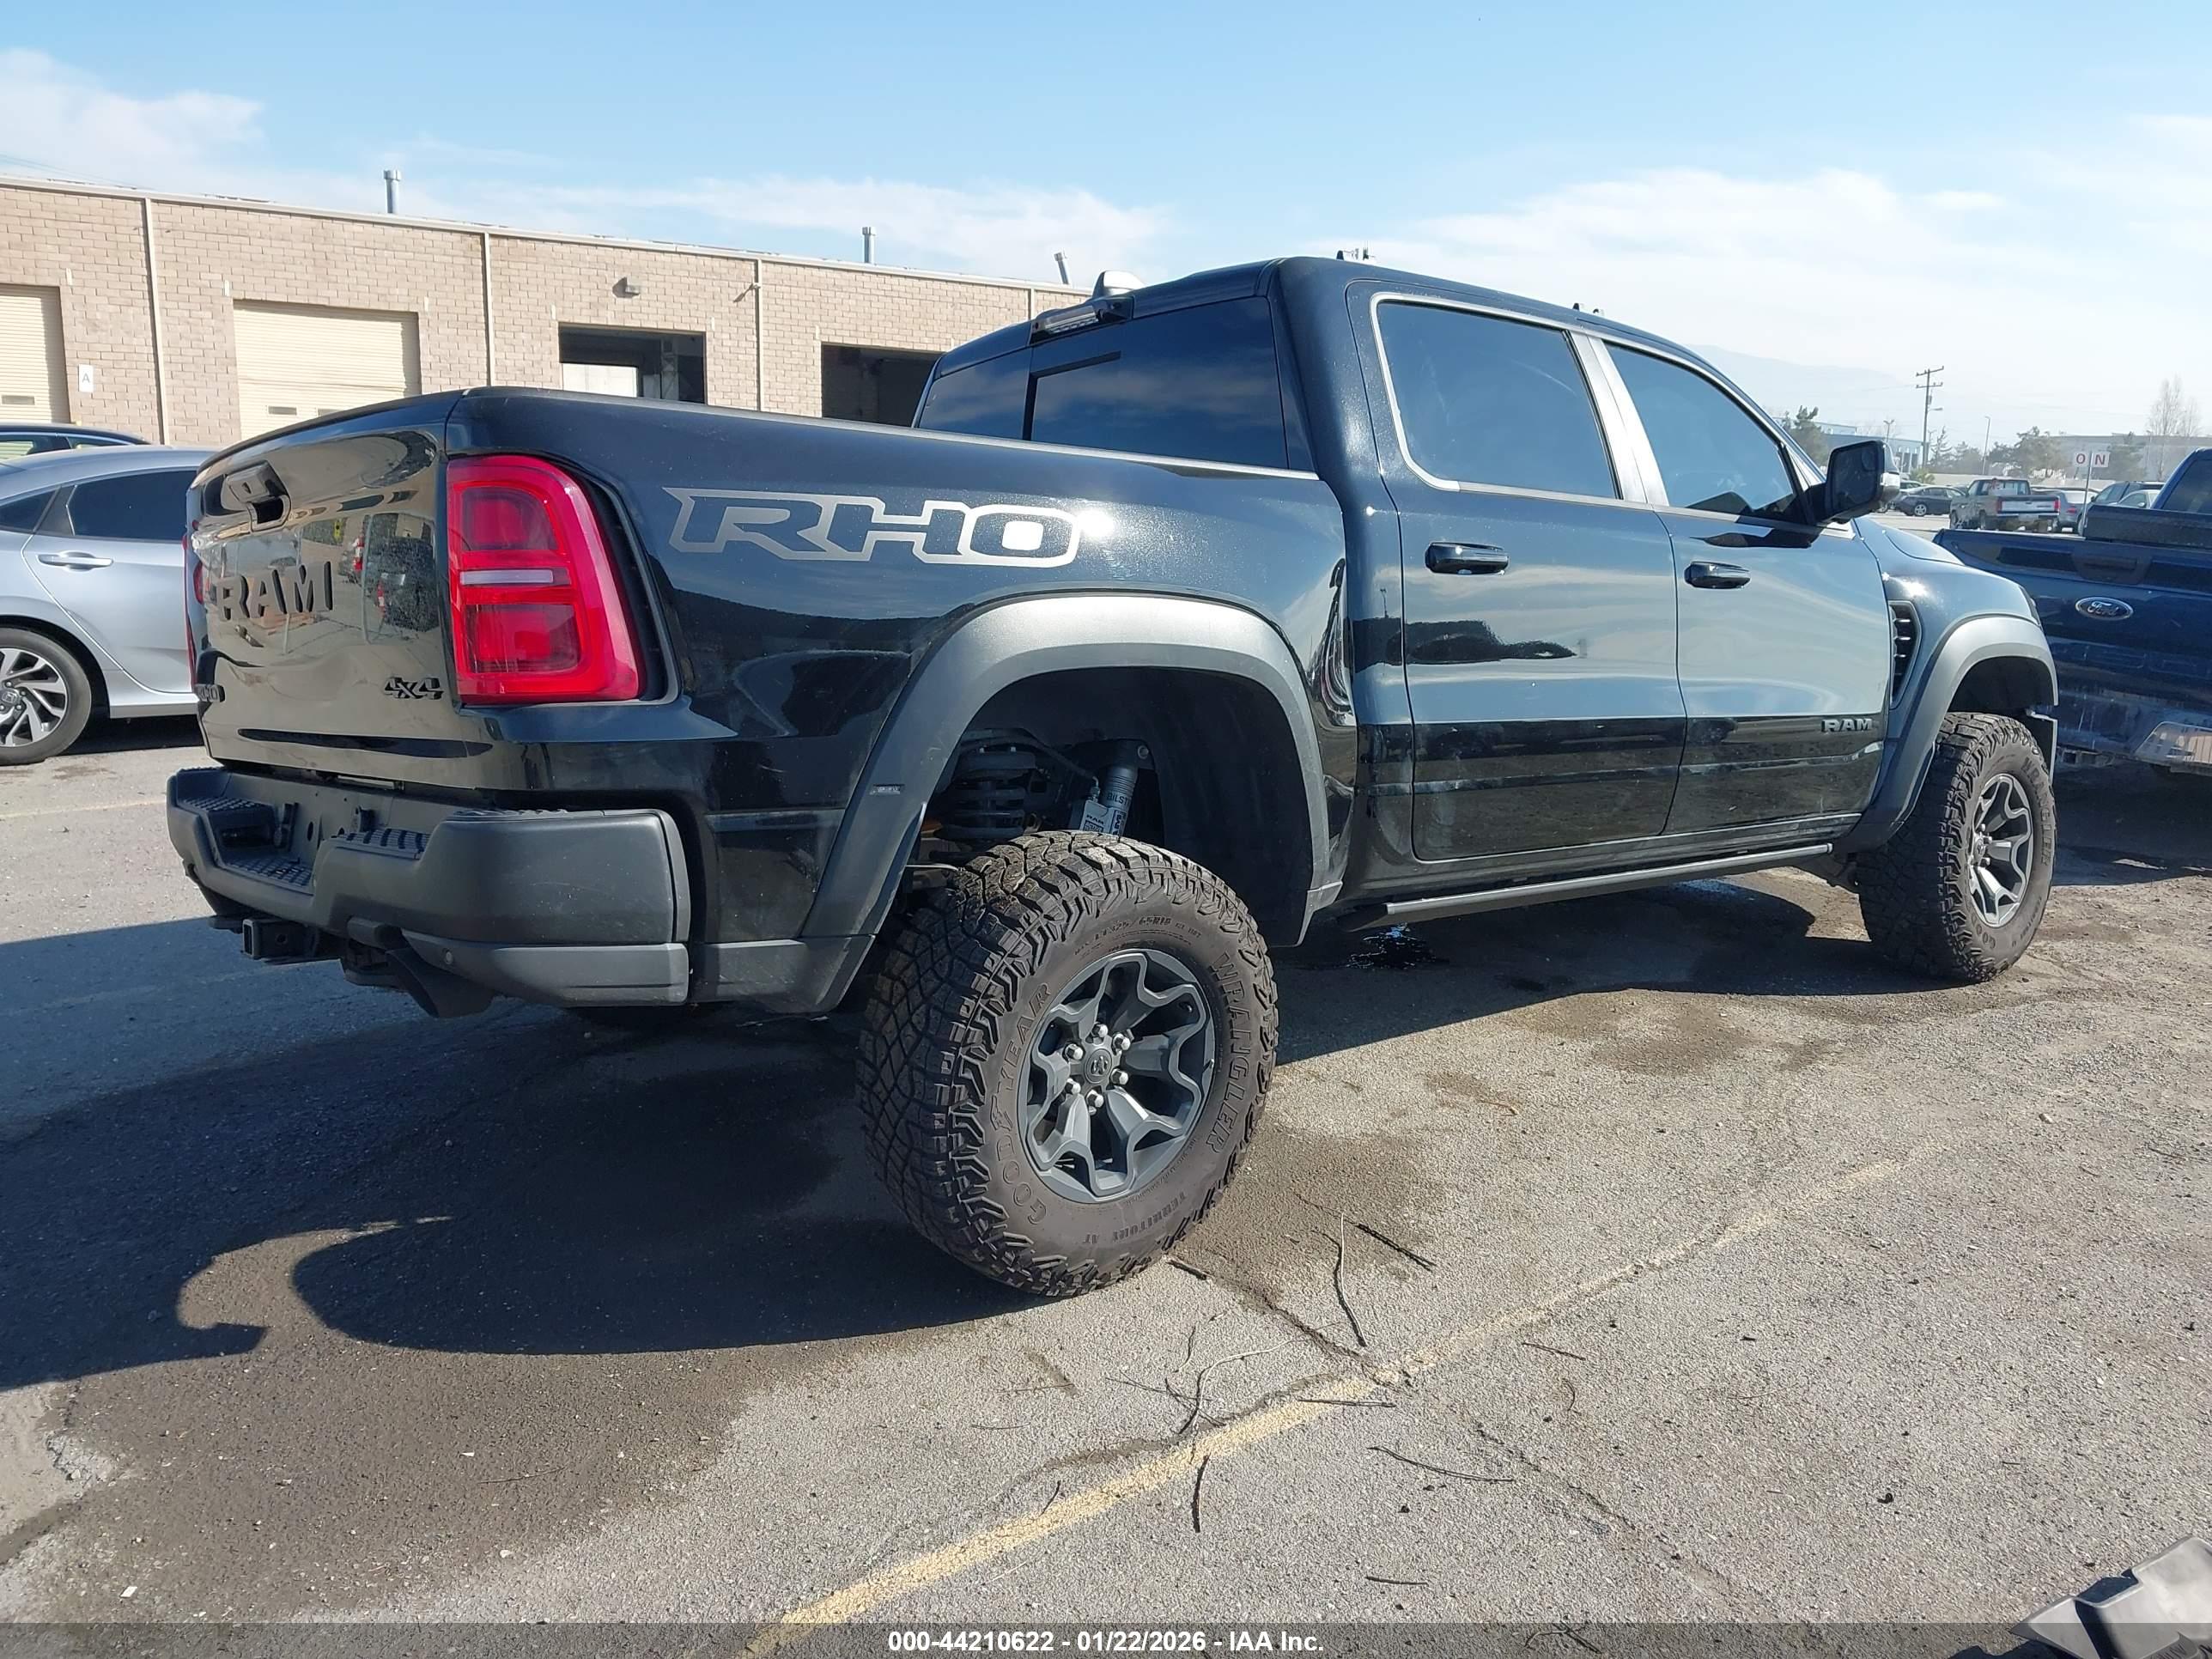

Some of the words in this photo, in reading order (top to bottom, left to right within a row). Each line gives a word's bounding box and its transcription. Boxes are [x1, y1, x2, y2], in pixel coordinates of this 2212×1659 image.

[82, 373, 90, 383] A
[662, 487, 1080, 568] RHO
[216, 561, 333, 621] RAM
[2087, 600, 2119, 617] Ford
[1821, 718, 1873, 732] RAM
[1206, 951, 1251, 1153] WRANGLER
